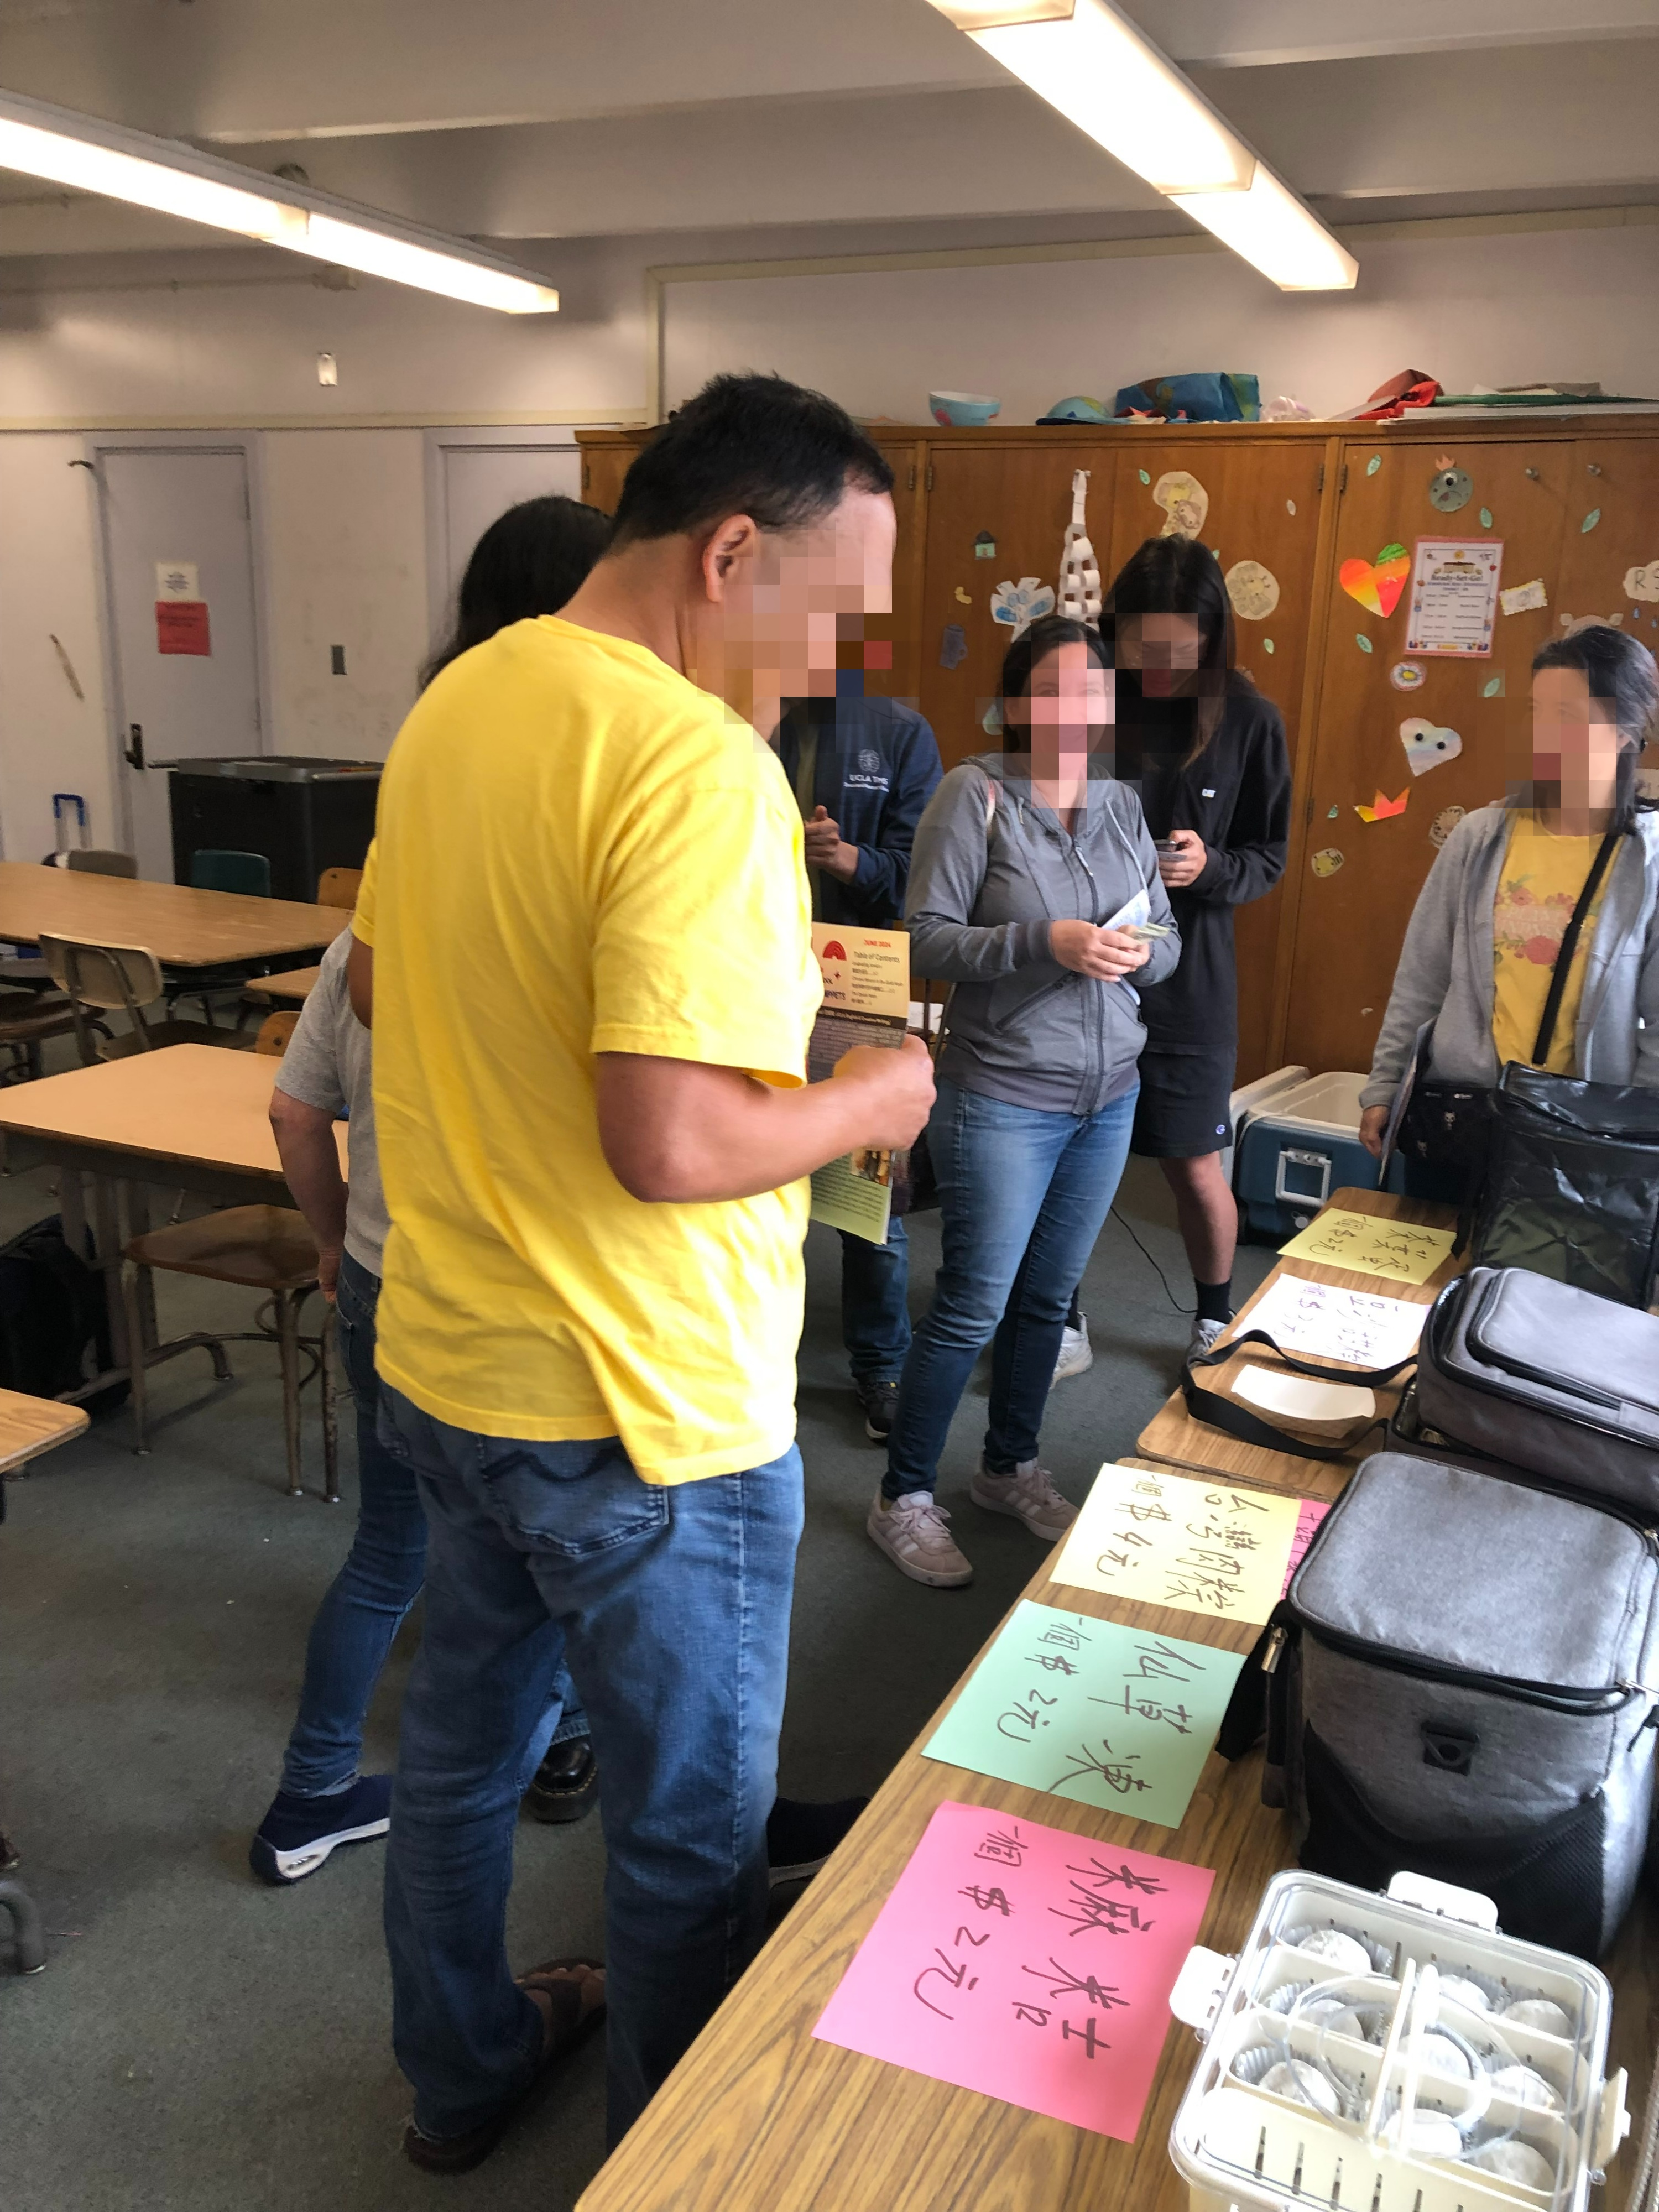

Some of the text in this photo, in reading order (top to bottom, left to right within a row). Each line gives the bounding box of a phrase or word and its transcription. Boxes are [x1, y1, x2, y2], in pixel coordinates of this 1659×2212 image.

[854, 951, 868, 959] Table
[876, 953, 900, 963] Contents
[1357, 1227, 1442, 1272] 茶葉蛋
[1164, 1494, 1269, 1609] 台灣肉粽
[1047, 1641, 1207, 1794] 仙草凍
